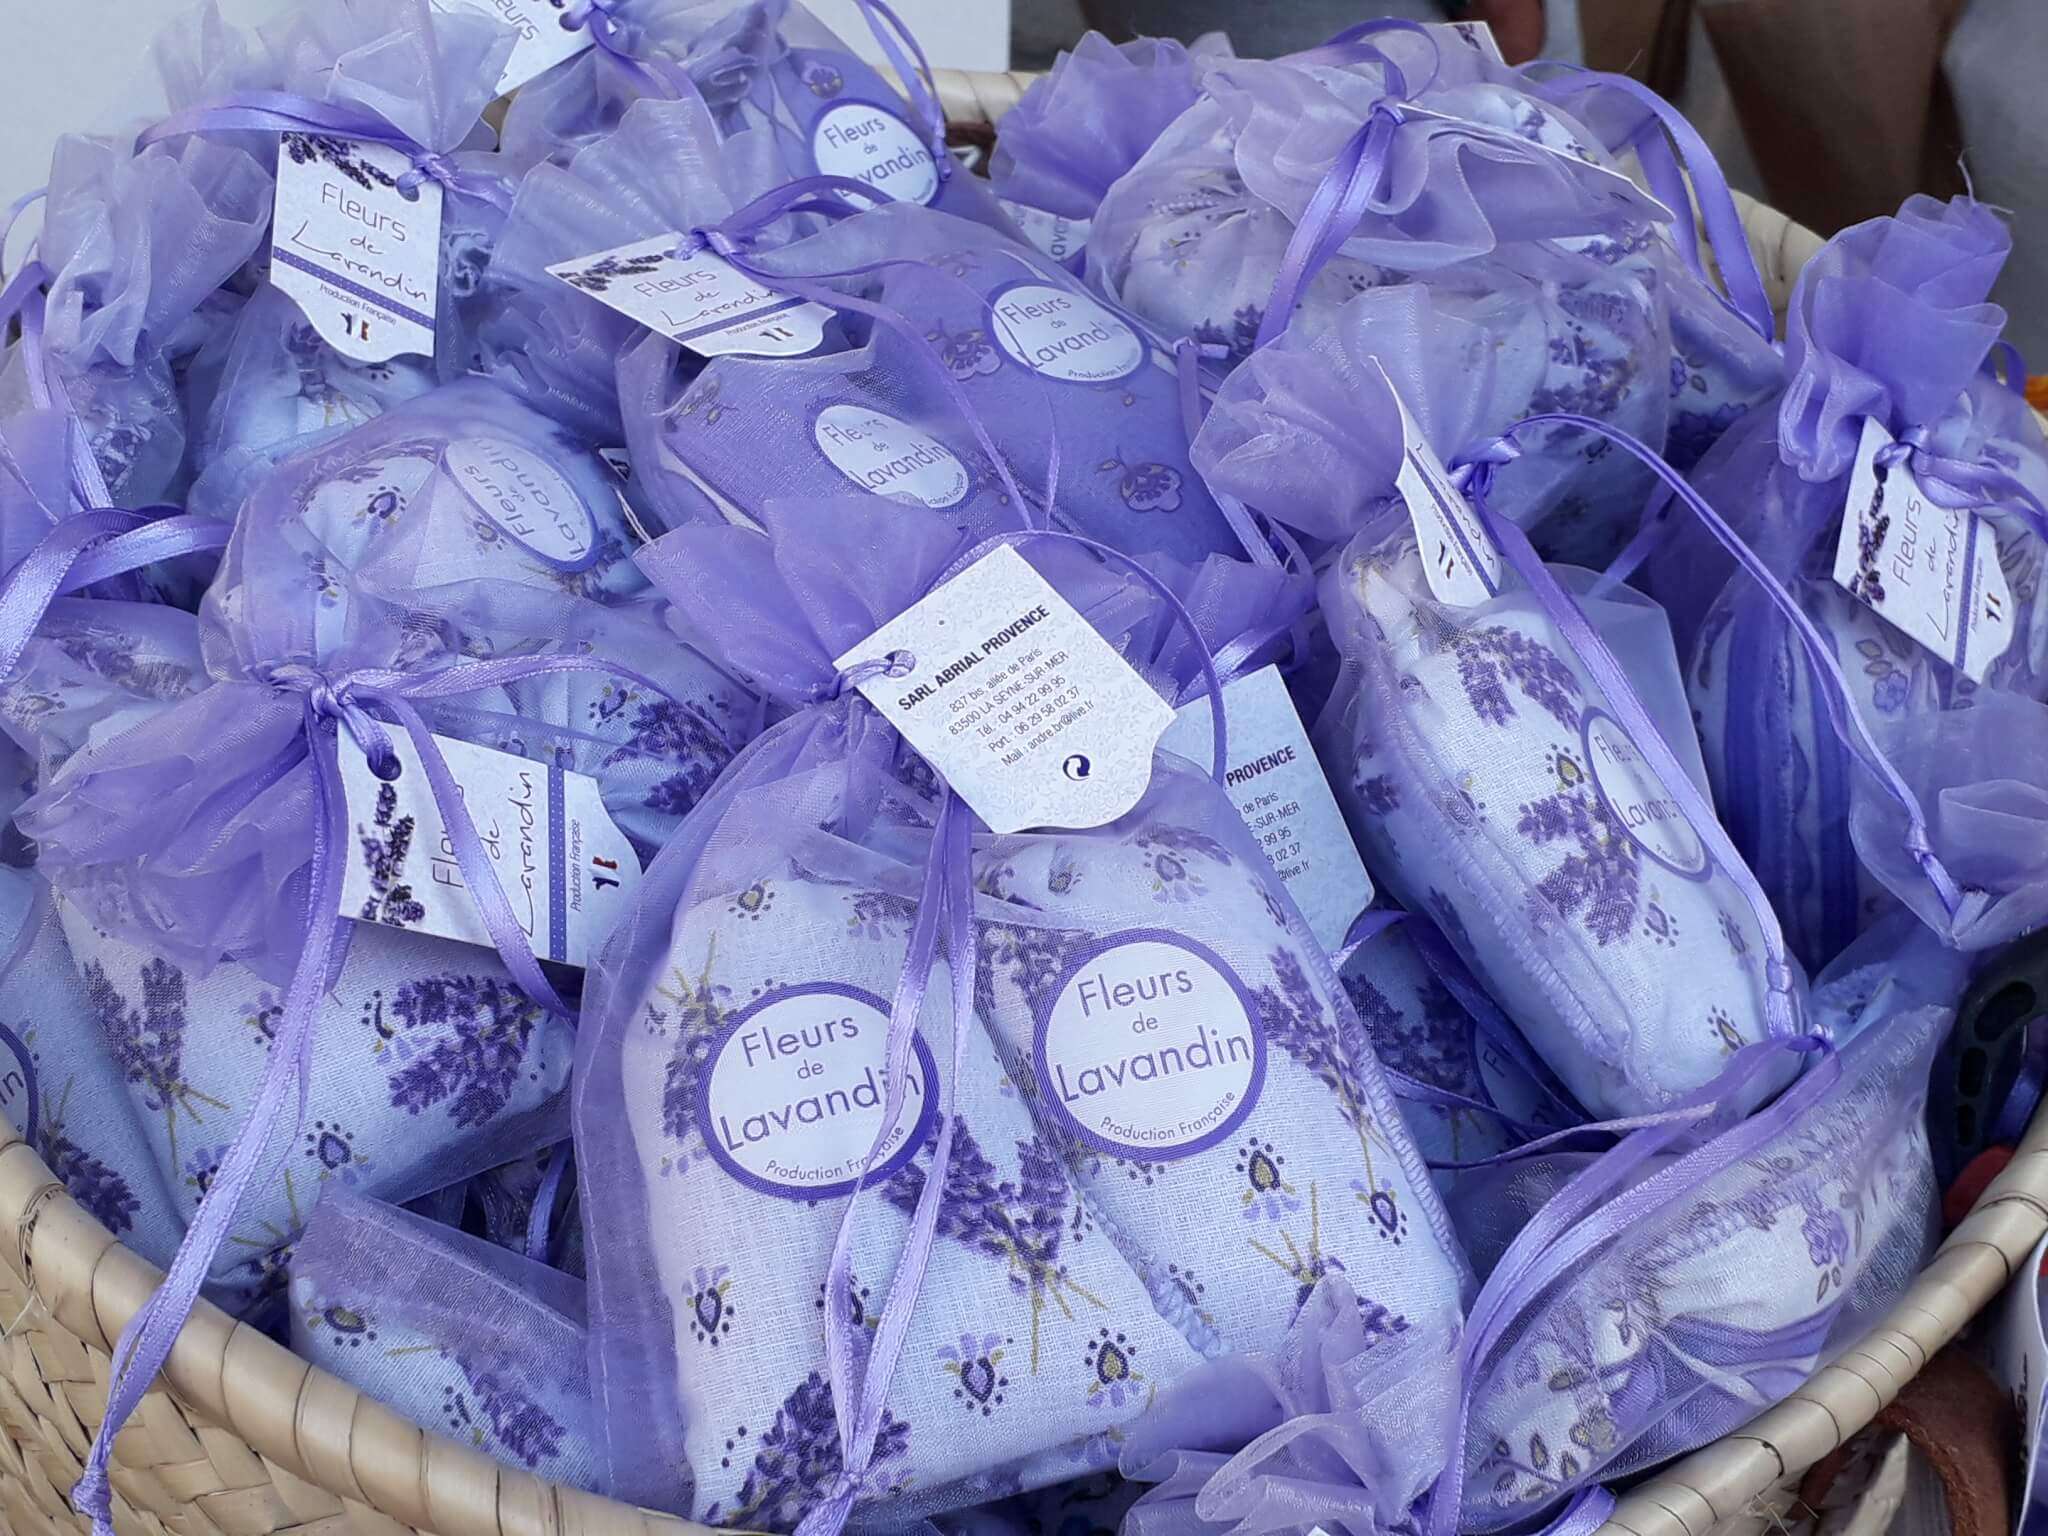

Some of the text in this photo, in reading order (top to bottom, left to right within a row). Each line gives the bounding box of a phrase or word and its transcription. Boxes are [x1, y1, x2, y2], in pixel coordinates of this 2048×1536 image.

[823, 117, 887, 150] Fleurs
[863, 142, 879, 155] de
[321, 182, 406, 242] Fleurs
[290, 219, 428, 302] Lavandin
[349, 235, 384, 255] de
[633, 268, 718, 298] Fleurs
[694, 290, 721, 303] de
[999, 297, 1073, 326] Fleurs
[848, 442, 951, 490] Lavandin
[463, 464, 536, 537] Fleurs
[1891, 495, 1922, 588] Fleurs
[1927, 537, 1937, 573] de
[898, 604, 1051, 712] SARL ABRIAL PROVENCE
[949, 695, 969, 713] 837
[985, 670, 1009, 690] allée
[1007, 662, 1021, 676] de
[1017, 647, 1043, 667] Paris
[948, 650, 1070, 736] 83500 LA SEYNE-SUR-MER
[998, 710, 1014, 725] 04
[1011, 701, 1028, 715] 94
[1024, 692, 1041, 706] 22
[1037, 683, 1054, 698] 99
[1050, 673, 1067, 689] 95
[1014, 721, 1030, 736] 06
[1026, 712, 1043, 728] 29
[1040, 703, 1057, 718] 58
[1053, 694, 1070, 709] 02
[1066, 685, 1080, 700] 37
[1000, 747, 1024, 767] Mail
[1027, 699, 1094, 751] andre.br@live.fr
[1226, 747, 1296, 787] PROVENCE
[1242, 802, 1255, 814] de
[1254, 791, 1280, 809] Paris
[508, 772, 538, 938] Lavandin
[1263, 831, 1278, 846] 99
[1275, 848, 1290, 862] 02
[1288, 841, 1302, 857] 37
[569, 857, 584, 913] Production
[1077, 969, 1194, 1019] Fleurs
[741, 1015, 860, 1068] Fleurs
[1131, 1012, 1160, 1035] de
[796, 1058, 825, 1081] de
[1054, 1024, 1251, 1103] Lavandin
[1100, 1091, 1236, 1142] Production Française
[764, 1158, 844, 1182] Production
